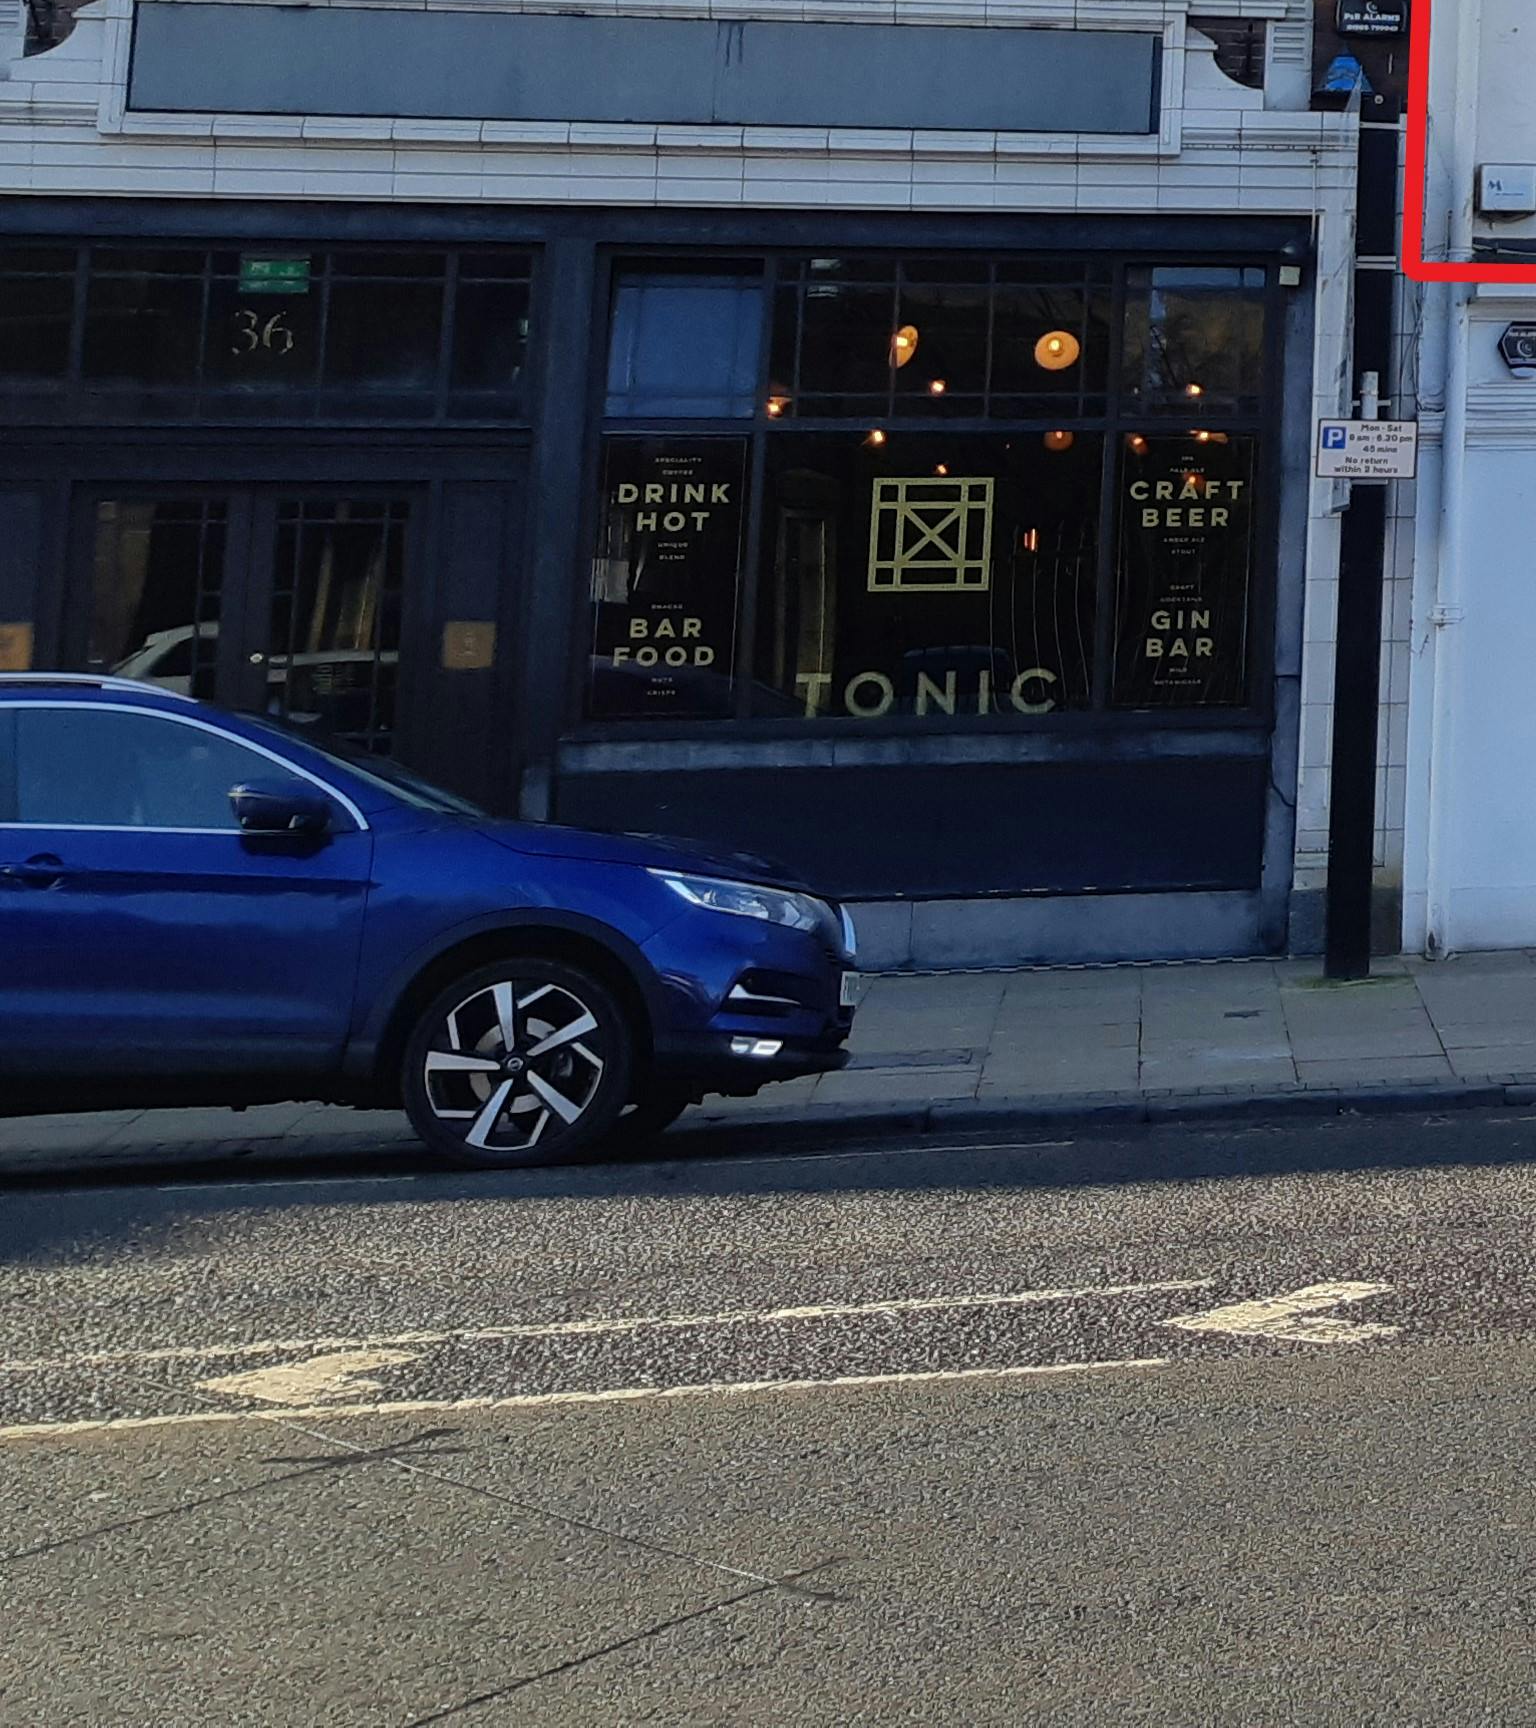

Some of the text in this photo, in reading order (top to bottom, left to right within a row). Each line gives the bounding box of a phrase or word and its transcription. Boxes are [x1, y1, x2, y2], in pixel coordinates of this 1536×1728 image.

[1363, 13, 1400, 21] ALARMS
[232, 310, 294, 354] 36
[1361, 424, 1380, 432] Mon
[1387, 424, 1402, 432] Sat
[1334, 465, 1361, 473] within
[1373, 465, 1398, 473] hours
[1345, 456, 1388, 464] No return
[618, 483, 731, 504] DRINK
[1130, 480, 1244, 500] CRAFT
[636, 512, 710, 531] HOT
[1142, 507, 1229, 527] BEER
[630, 618, 702, 638] BAR
[1151, 609, 1210, 629] GIN
[612, 646, 715, 667] FOOD
[1145, 637, 1213, 657] BAR
[795, 668, 1057, 719] TONIC
